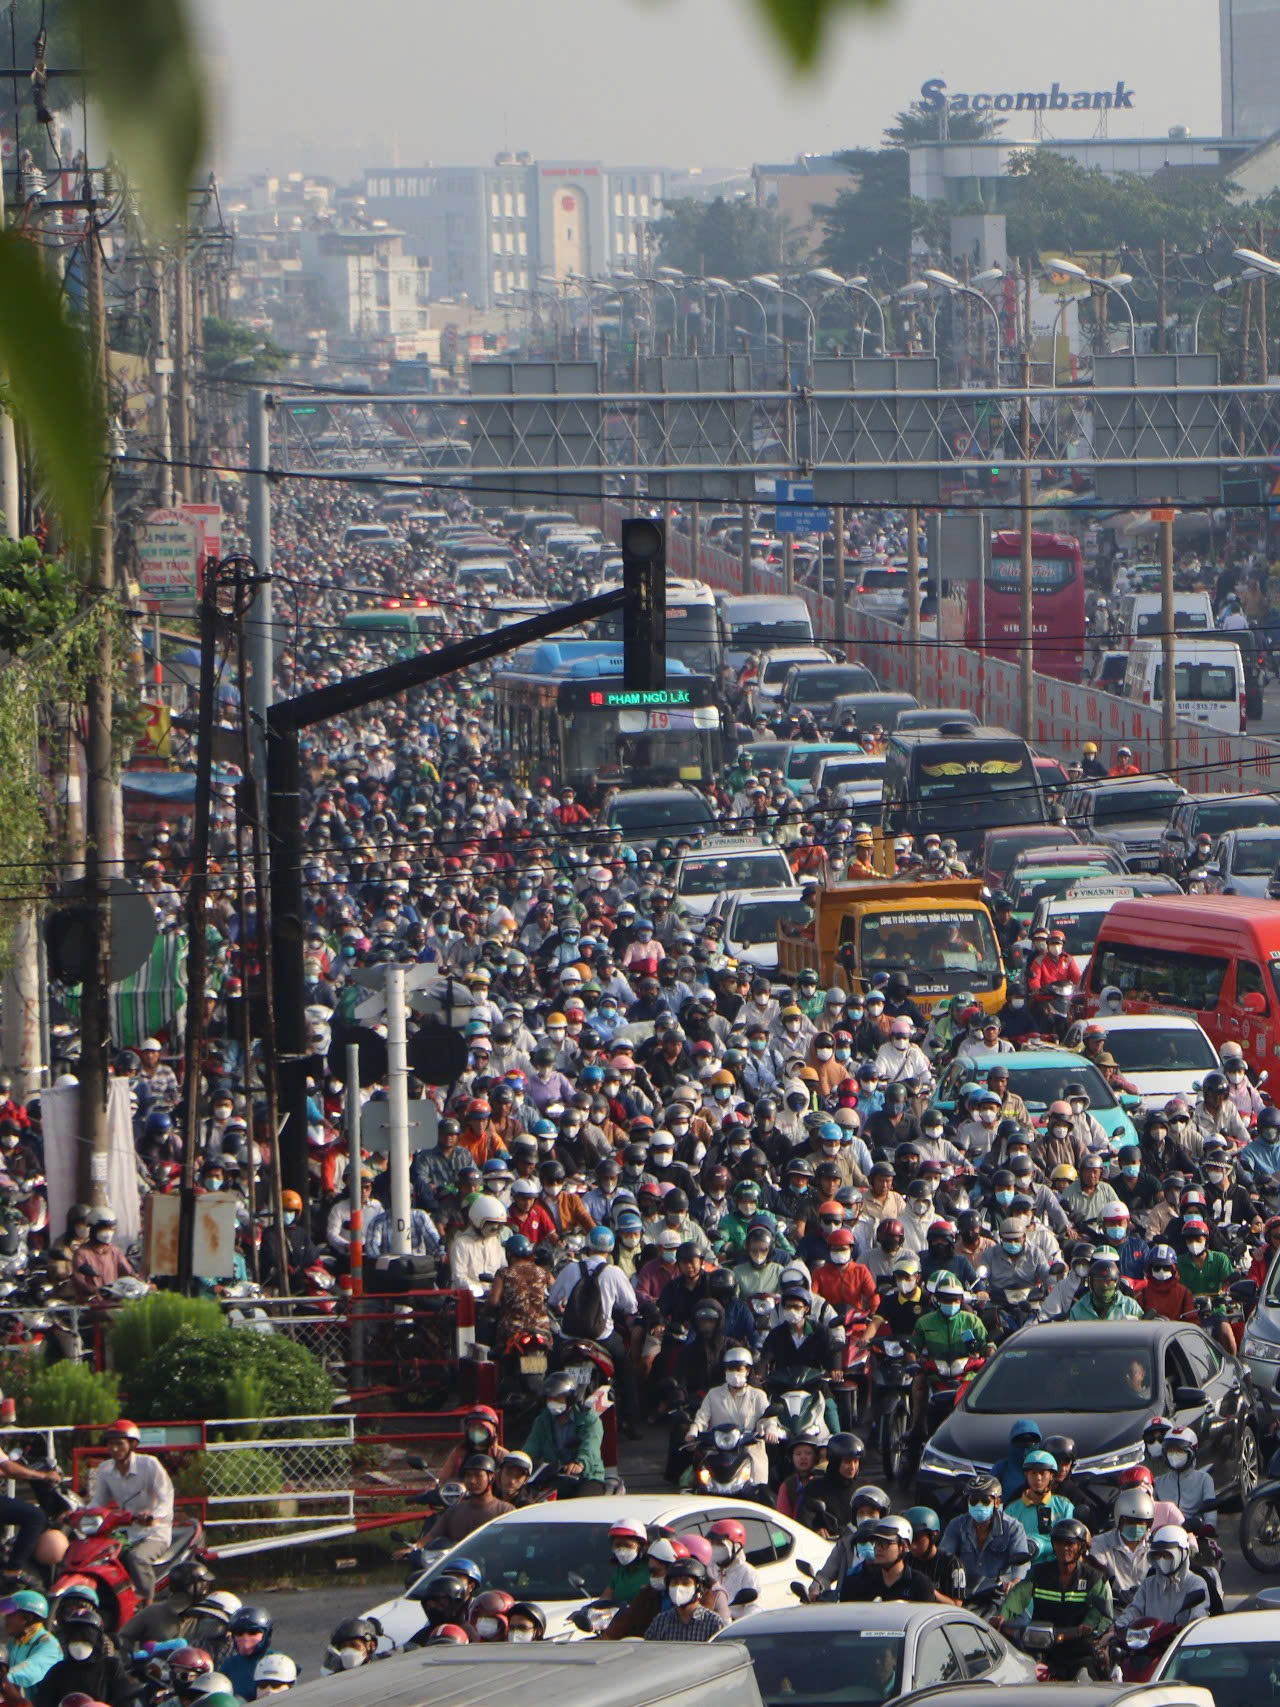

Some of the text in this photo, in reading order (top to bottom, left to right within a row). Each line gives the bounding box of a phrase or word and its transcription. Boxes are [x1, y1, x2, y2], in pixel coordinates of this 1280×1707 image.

[919, 78, 1136, 112] Sacombank
[651, 713, 668, 729] 19
[1080, 888, 1114, 896] VINASUN
[915, 985, 949, 993] ISUZU
